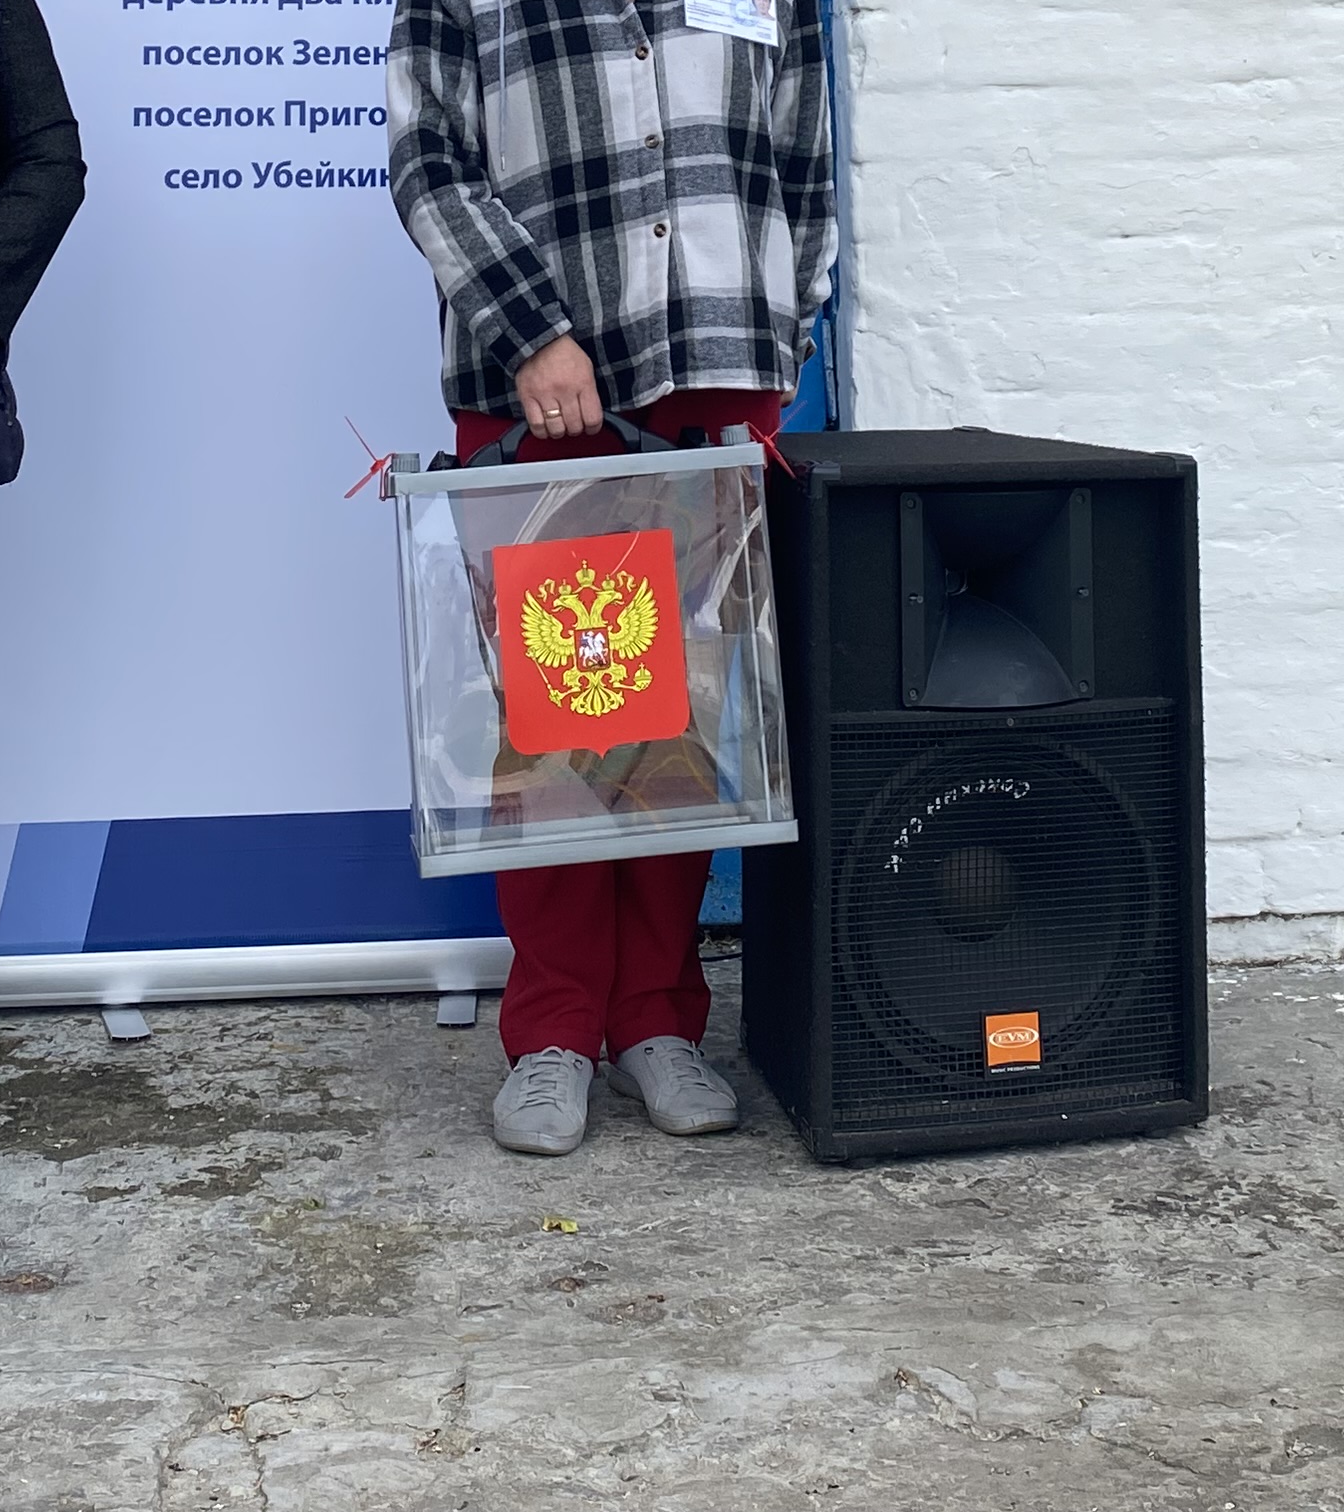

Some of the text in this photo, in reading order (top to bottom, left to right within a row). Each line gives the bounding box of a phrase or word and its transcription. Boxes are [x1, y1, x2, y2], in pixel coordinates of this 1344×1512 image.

[142, 39, 389, 66] поселок Зелен
[132, 100, 388, 132] поселок Приго
[164, 168, 243, 189] село
